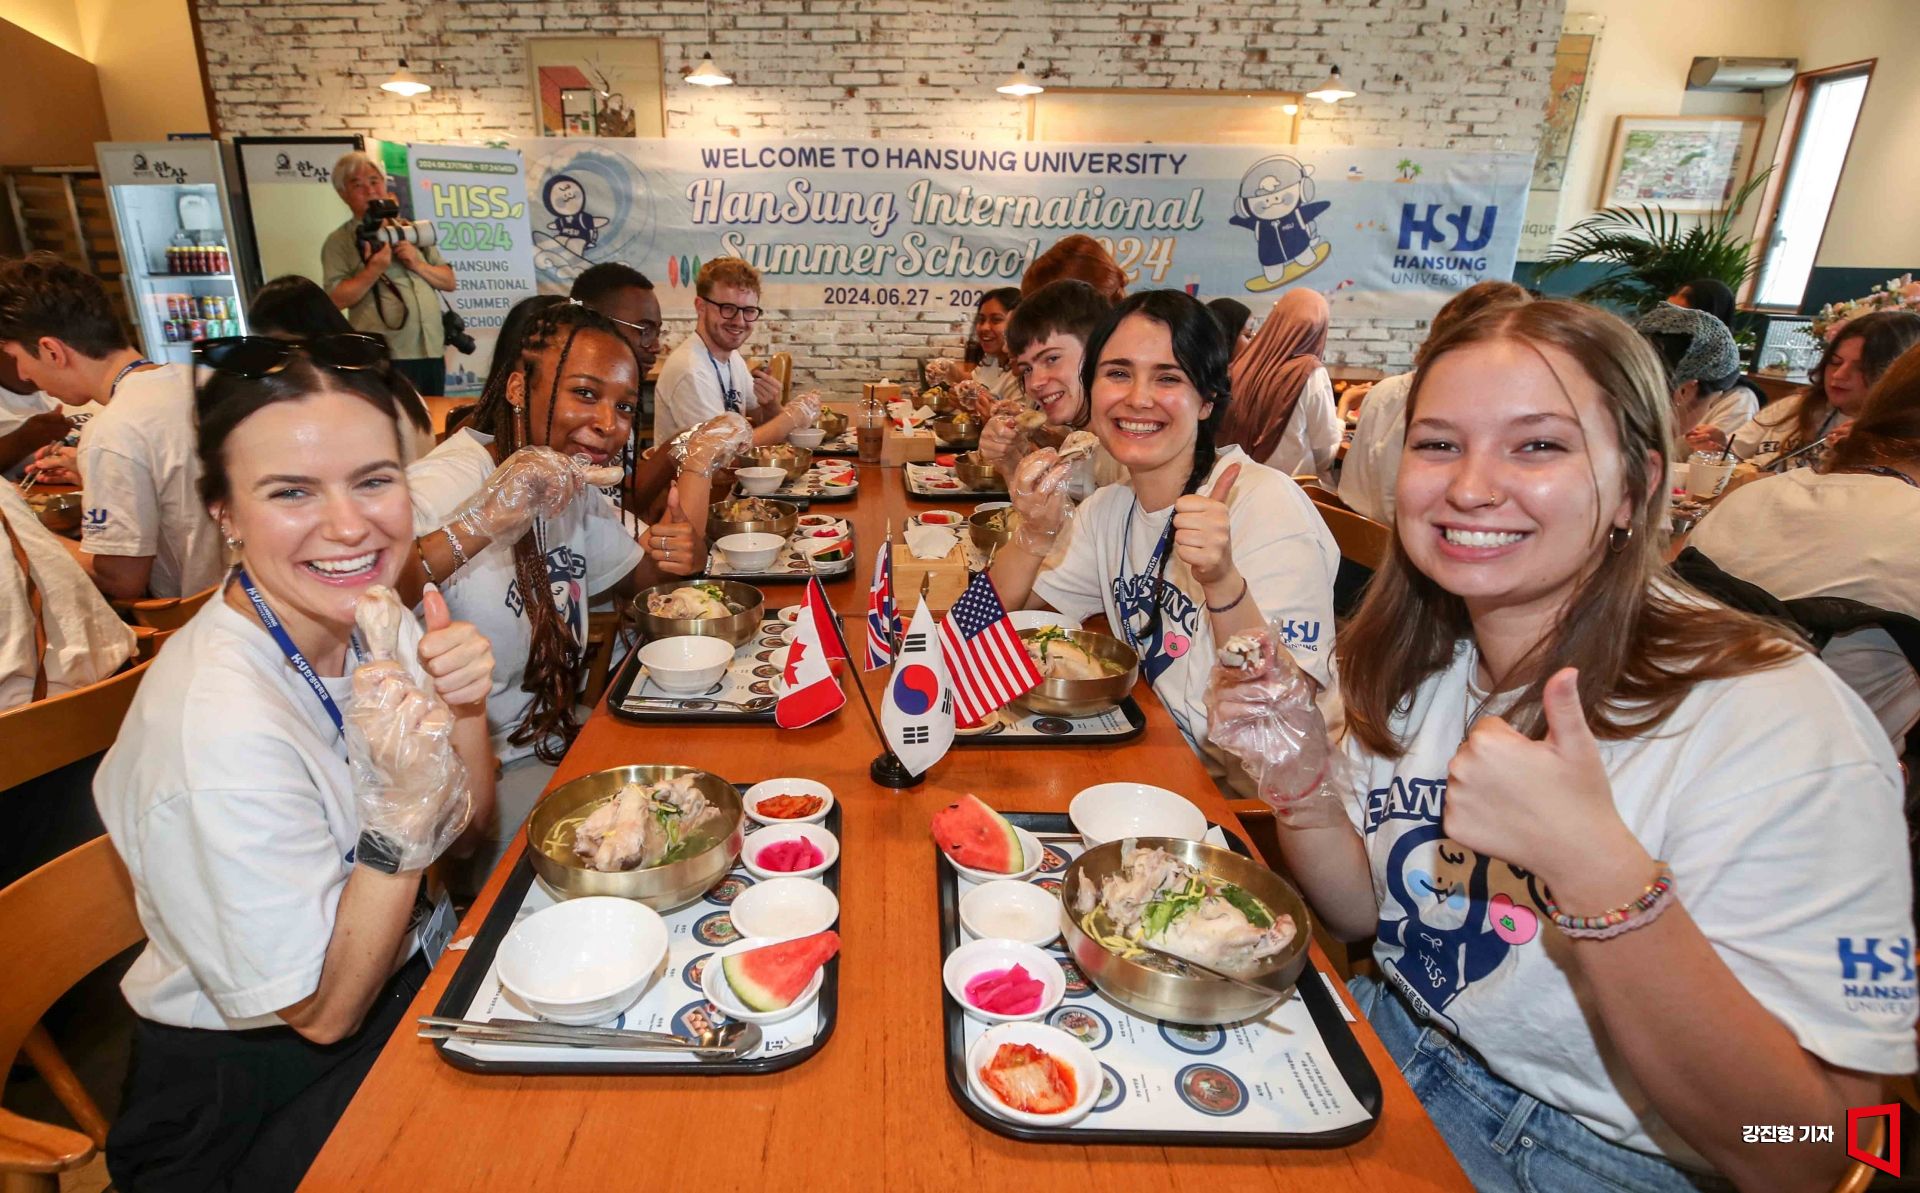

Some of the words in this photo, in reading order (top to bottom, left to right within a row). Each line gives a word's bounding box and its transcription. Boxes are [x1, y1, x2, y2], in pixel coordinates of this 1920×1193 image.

[701, 147, 836, 169] WELCOME
[842, 148, 879, 169] TO
[886, 148, 1016, 172] HANSUNG
[1024, 151, 1187, 175] UNIVERSITY
[432, 183, 512, 219] HISS
[686, 177, 898, 237] HanSung
[907, 179, 1204, 231] International
[437, 221, 513, 251] 2024
[1397, 203, 1498, 252] HSU
[1393, 255, 1487, 271] HANSUNG
[1391, 272, 1483, 287] UNIVERSITY
[457, 298, 510, 309] SUMMER
[824, 288, 929, 306] 2024.06.27
[1418, 947, 1447, 989] HISS
